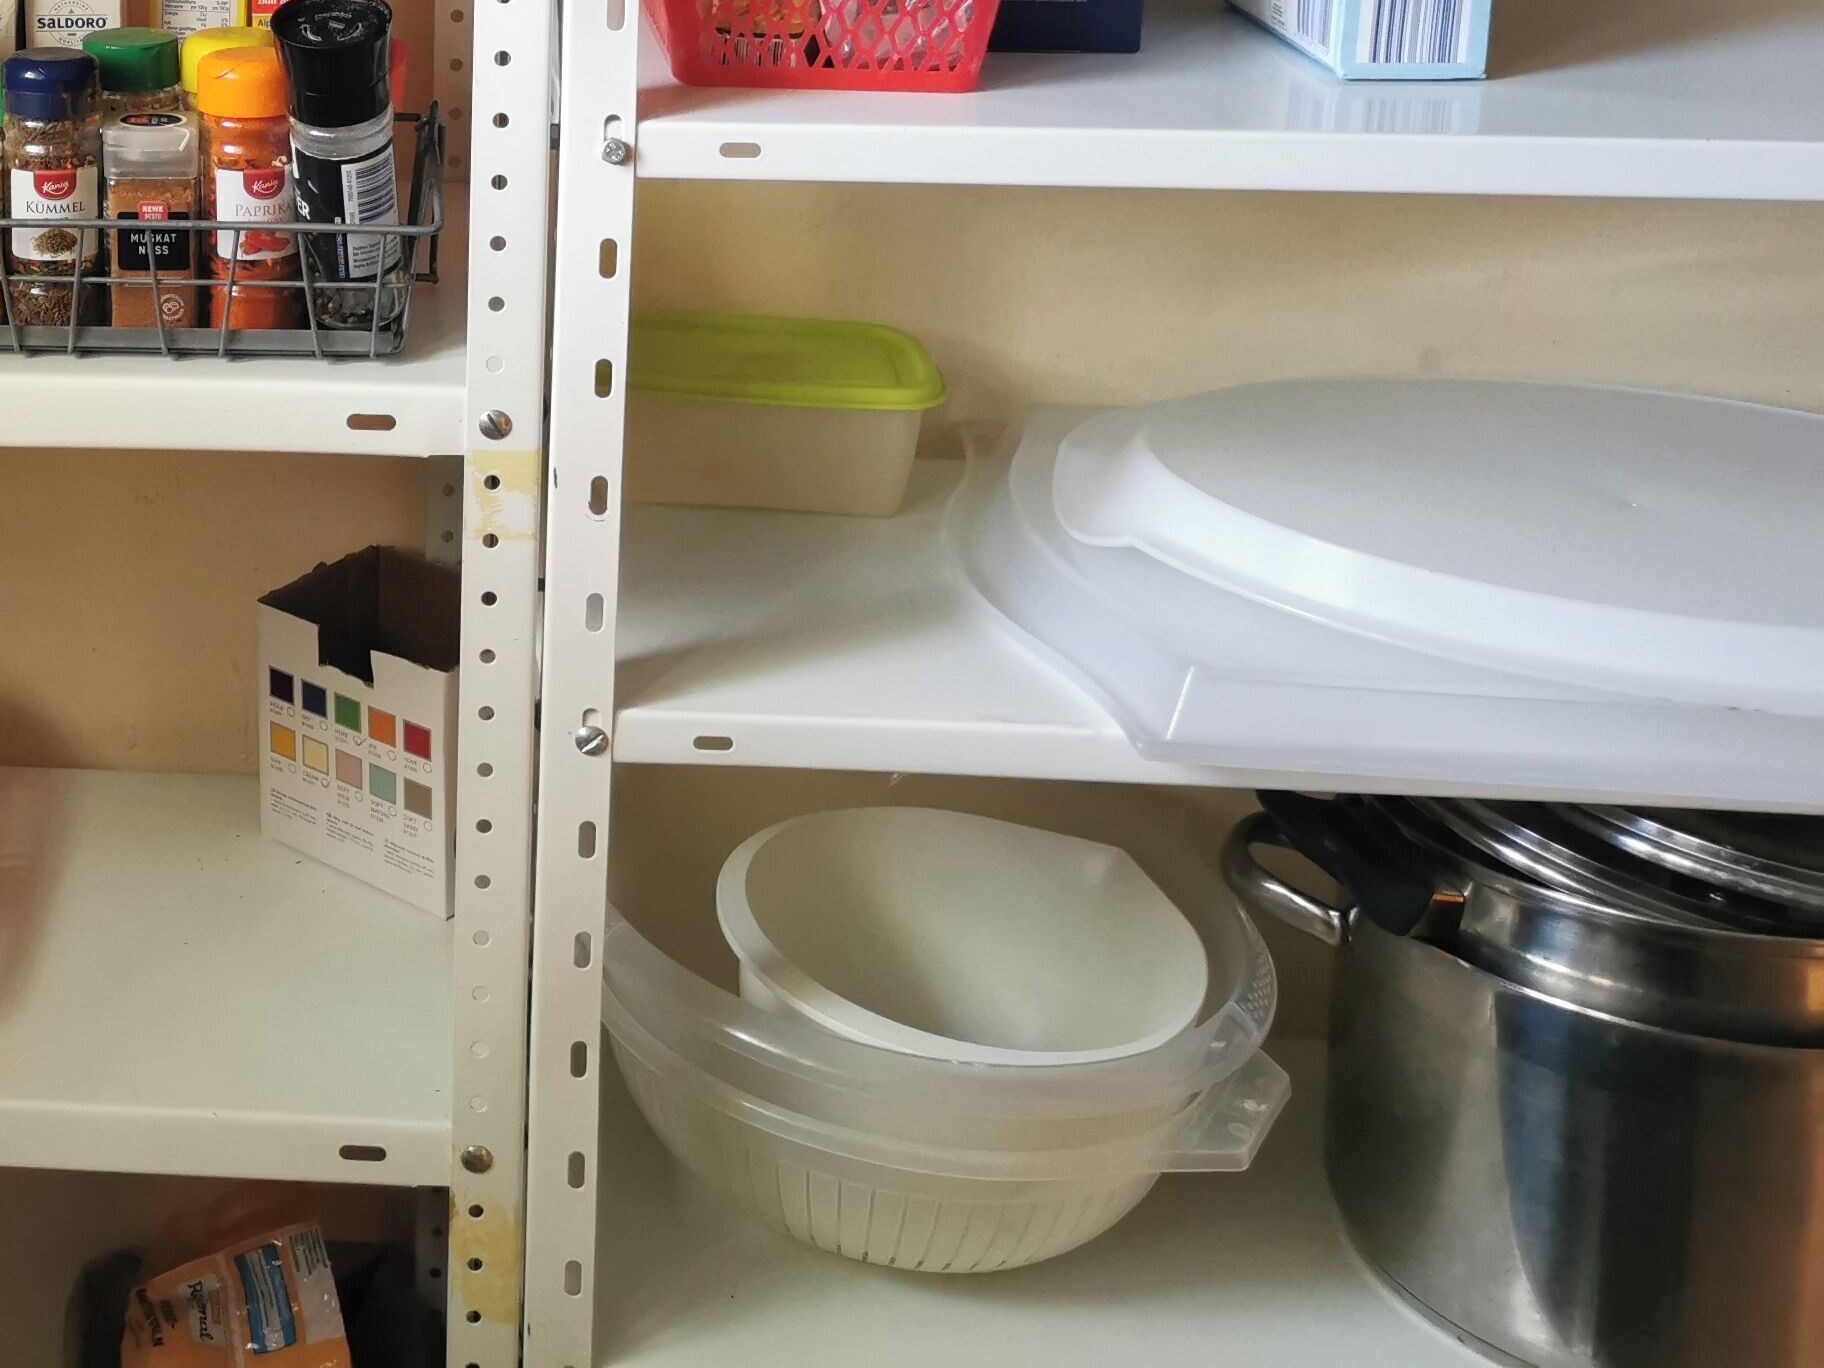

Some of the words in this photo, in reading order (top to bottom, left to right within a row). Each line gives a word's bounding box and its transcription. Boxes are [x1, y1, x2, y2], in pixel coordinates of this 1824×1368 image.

[41, 180, 70, 194] Kania
[26, 200, 86, 214] KÜMMEL
[142, 205, 164, 213] REWE
[235, 202, 293, 218] PAPRIKA
